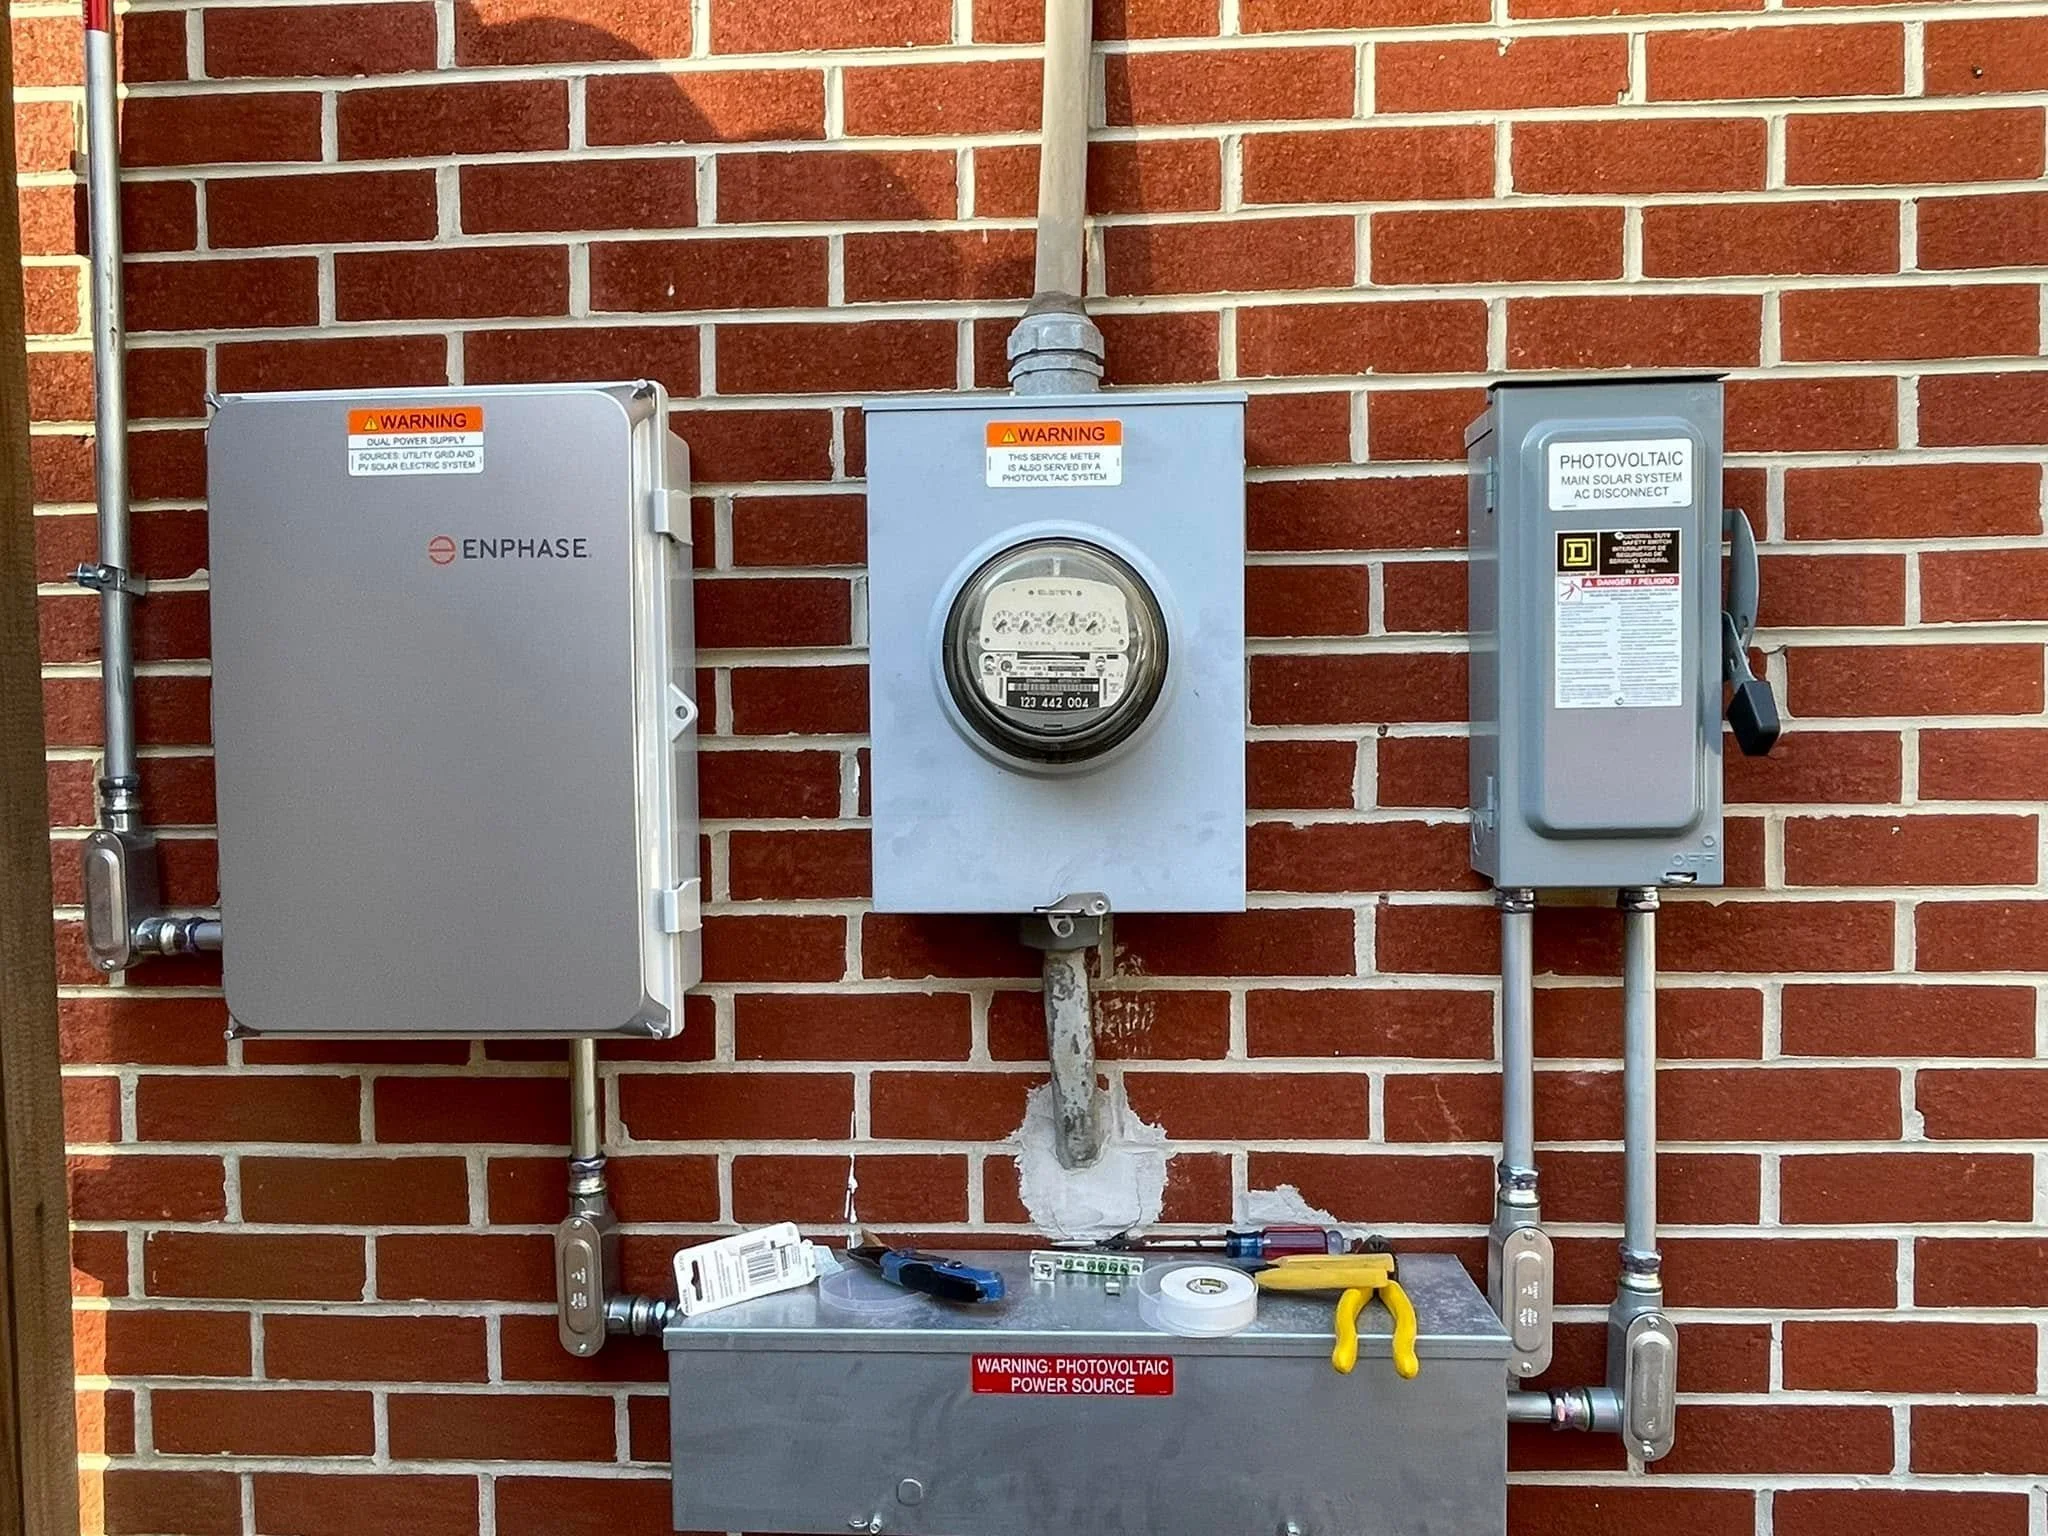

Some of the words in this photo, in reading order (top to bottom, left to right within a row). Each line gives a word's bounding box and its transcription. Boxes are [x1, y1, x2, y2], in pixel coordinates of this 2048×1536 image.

[380, 413, 467, 429] WARNING
[367, 438, 391, 446] DUAL
[393, 437, 427, 446] POWER
[430, 435, 466, 445] SUPPLY
[1018, 426, 1106, 442] WARNING
[402, 451, 432, 460] UTILITY
[434, 450, 455, 459] GRID
[457, 450, 475, 459] AND
[1008, 453, 1029, 461] THIS
[1030, 452, 1068, 461] SERVICE
[1070, 452, 1101, 460] METER
[1560, 451, 1683, 470] PHOTOVOLTAIC
[358, 463, 369, 471] PV
[371, 462, 398, 471] SOLAR
[400, 461, 440, 470] ELECTRIC
[442, 460, 476, 470] SYSTEM
[1008, 464, 1017, 472] IS
[1018, 463, 1042, 472] ALSO
[1043, 463, 1079, 471] SERVED
[1081, 462, 1093, 471] BY
[1094, 462, 1101, 470] A
[1002, 473, 1069, 483] PHOTOVOLTAIC
[1071, 472, 1107, 481] SYSTEM
[1561, 475, 1590, 486] MAIN
[1592, 473, 1632, 485] SOLAR
[1634, 471, 1683, 484] SYSTEM
[1574, 488, 1590, 500] AC
[1593, 486, 1669, 499] DISCONNECT
[463, 538, 588, 559] ENPHASE
[1597, 578, 1632, 586] DANGER
[1638, 577, 1675, 586] PELIGRO
[1020, 696, 1036, 708] 123
[1041, 696, 1063, 708] 442
[1067, 696, 1089, 708] 004
[977, 1358, 1052, 1374] WARNING:
[1056, 1358, 1169, 1375] PHOTOVOLTAIC
[1011, 1377, 1068, 1393] POWER
[1072, 1378, 1136, 1394] SOURCE
